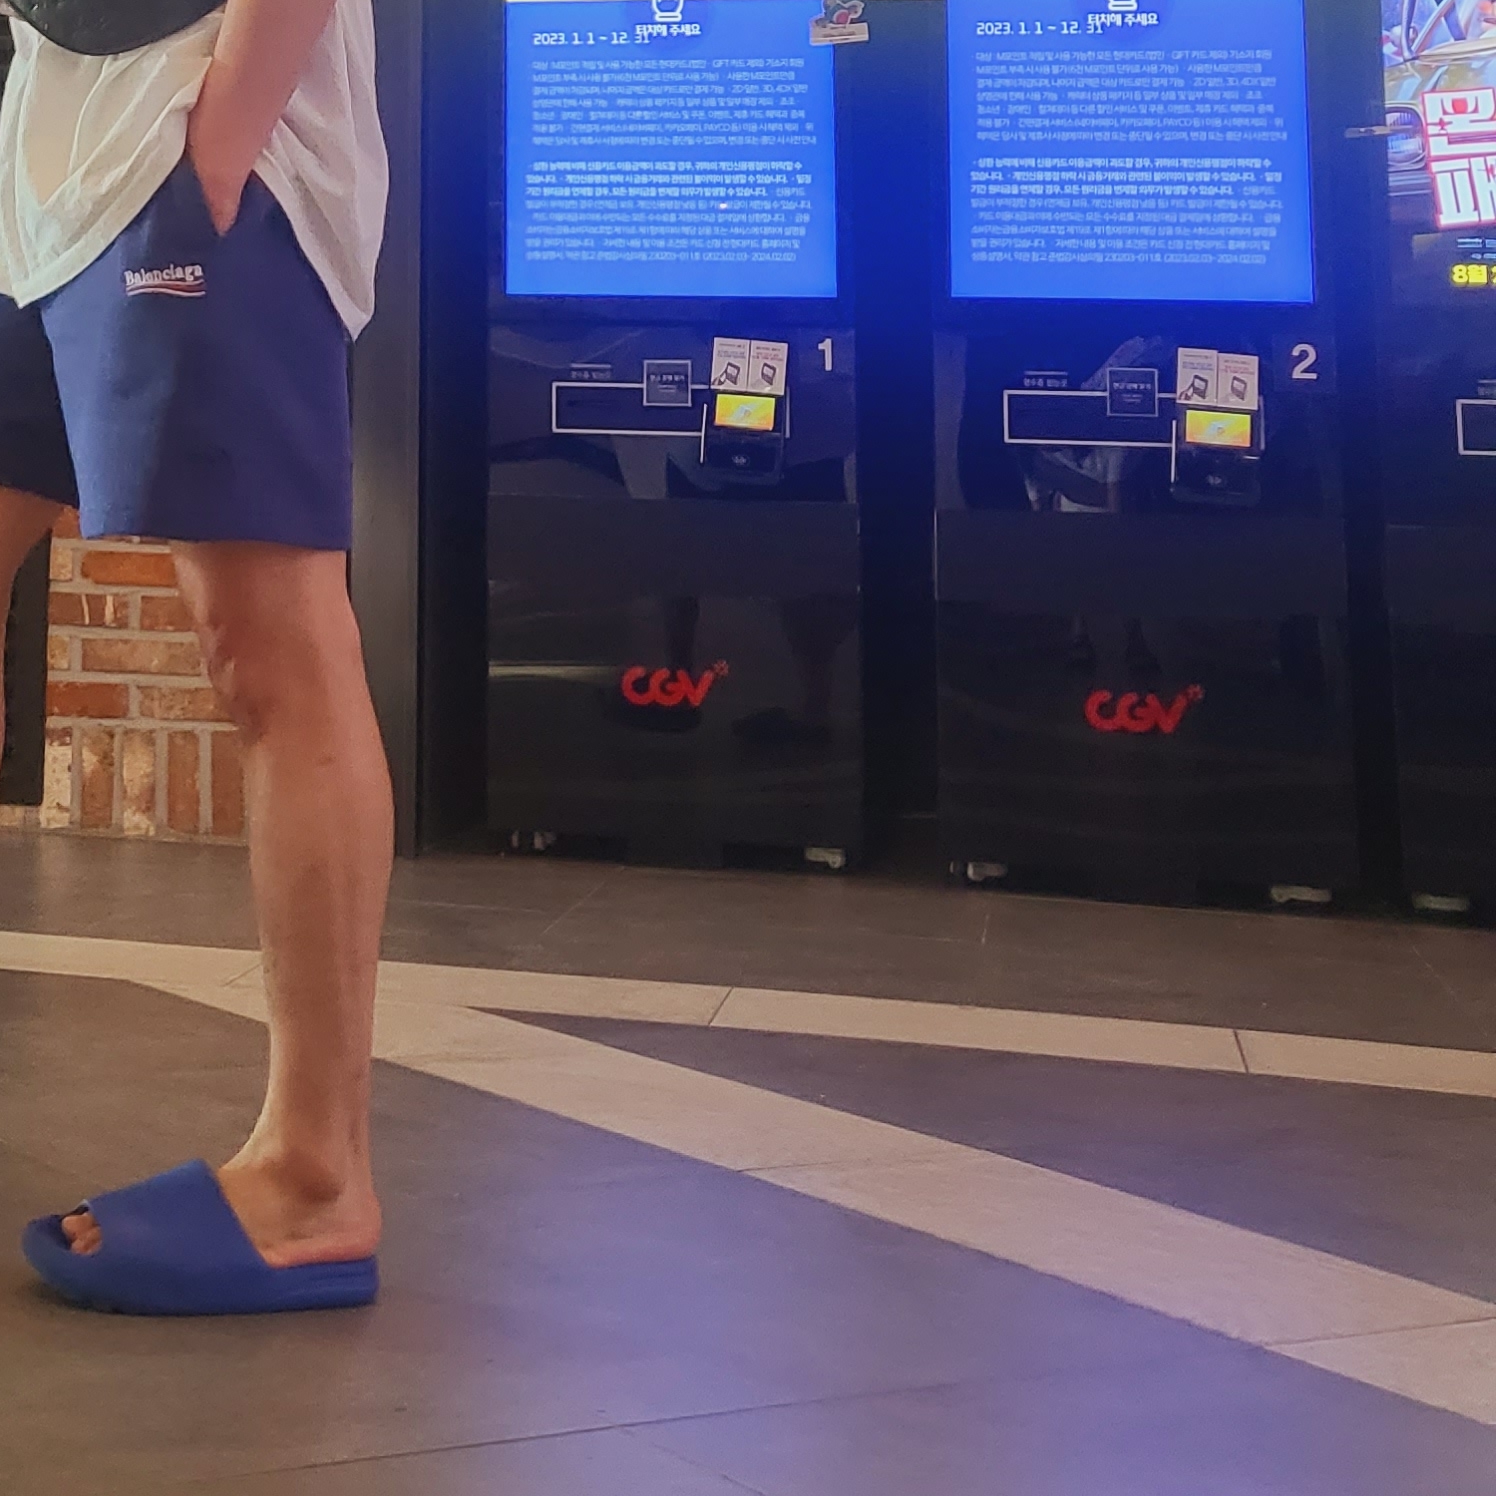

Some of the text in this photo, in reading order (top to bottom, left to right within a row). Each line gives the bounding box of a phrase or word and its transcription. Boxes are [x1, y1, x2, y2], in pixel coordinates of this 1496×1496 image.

[669, 23, 702, 37] 주세요
[975, 22, 1014, 35] 2023.
[1124, 12, 1159, 27] 주세요
[532, 32, 568, 45] 2023.
[817, 337, 833, 372] 1
[1291, 343, 1319, 380] 2
[621, 664, 712, 707] CGV
[1084, 689, 1191, 735] CGV
